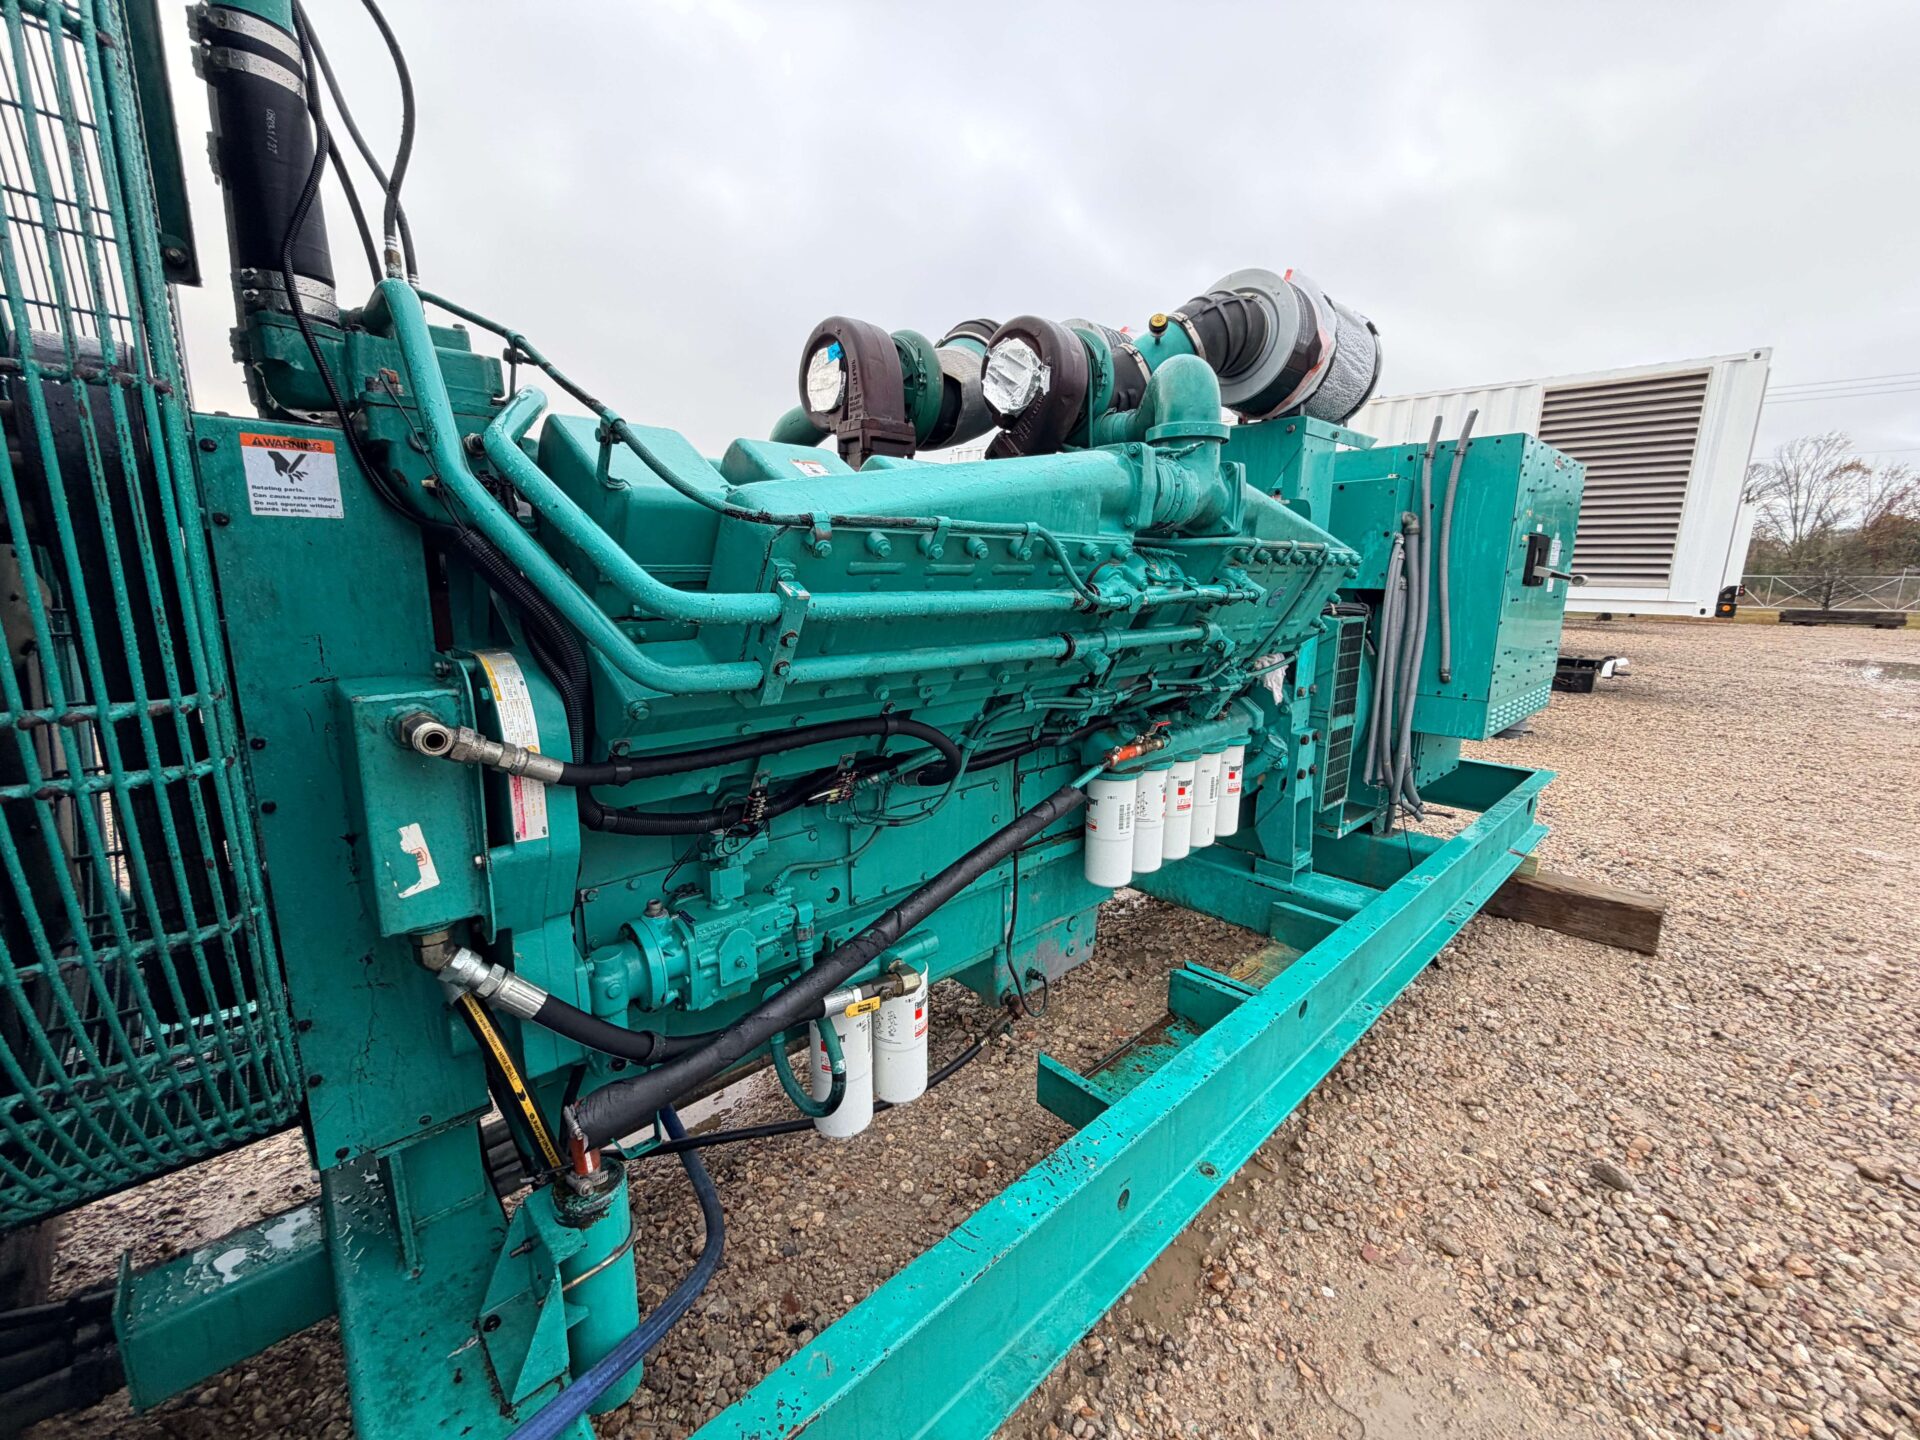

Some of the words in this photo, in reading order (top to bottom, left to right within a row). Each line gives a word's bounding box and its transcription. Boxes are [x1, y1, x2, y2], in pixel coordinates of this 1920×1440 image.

[263, 438, 322, 451] WARNING
[251, 484, 282, 492] Rotating
[284, 485, 305, 493] parts.
[280, 501, 308, 509] operate
[290, 506, 312, 514] place.
